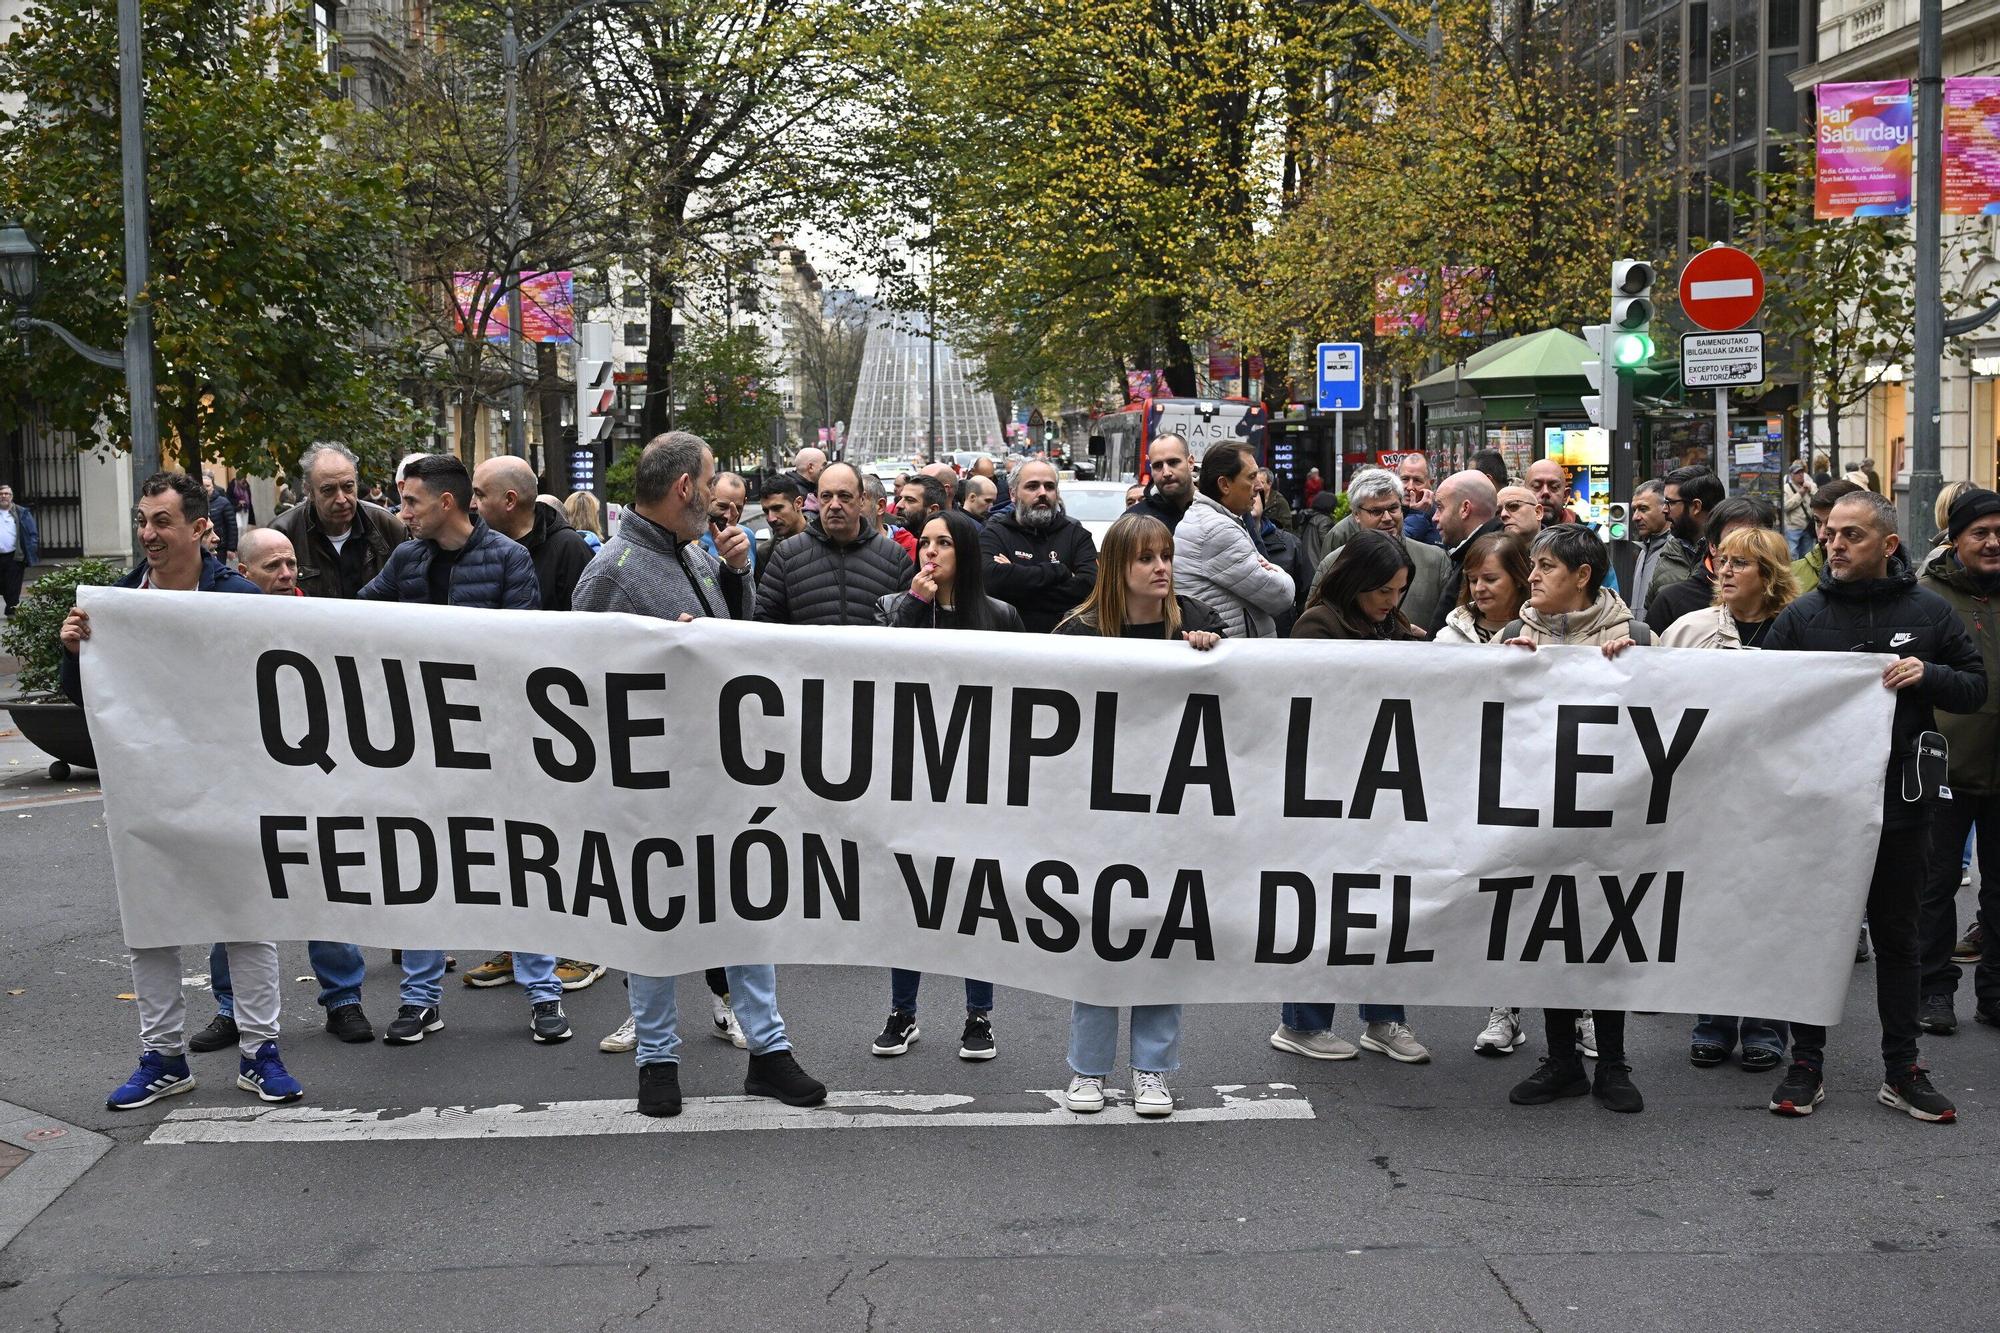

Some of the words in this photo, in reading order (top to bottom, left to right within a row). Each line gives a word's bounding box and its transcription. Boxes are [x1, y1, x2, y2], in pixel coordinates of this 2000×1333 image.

[1821, 106, 1853, 123] Fair
[1821, 123, 1908, 144] Saturday
[1696, 338, 1749, 346] BAIMENDUTAKO
[1686, 347, 1727, 356] IBILGAILUAK
[1728, 346, 1744, 354] IZAN
[1745, 345, 1760, 353] EZIK
[1688, 365, 1719, 373] EXCEPTO
[1700, 373, 1747, 381] AUTORIZADOS
[1893, 632, 1912, 641] NIKE
[257, 650, 491, 775] QUE
[526, 667, 670, 789] SE
[719, 675, 1235, 817] CUMPLA
[1284, 698, 1427, 821] LA
[1478, 702, 1709, 828] LEY
[260, 807, 859, 931] FEDERACIÓN
[894, 853, 1215, 961] VASCA
[1255, 871, 1434, 965] DEL
[1479, 871, 1684, 963] TAXI
